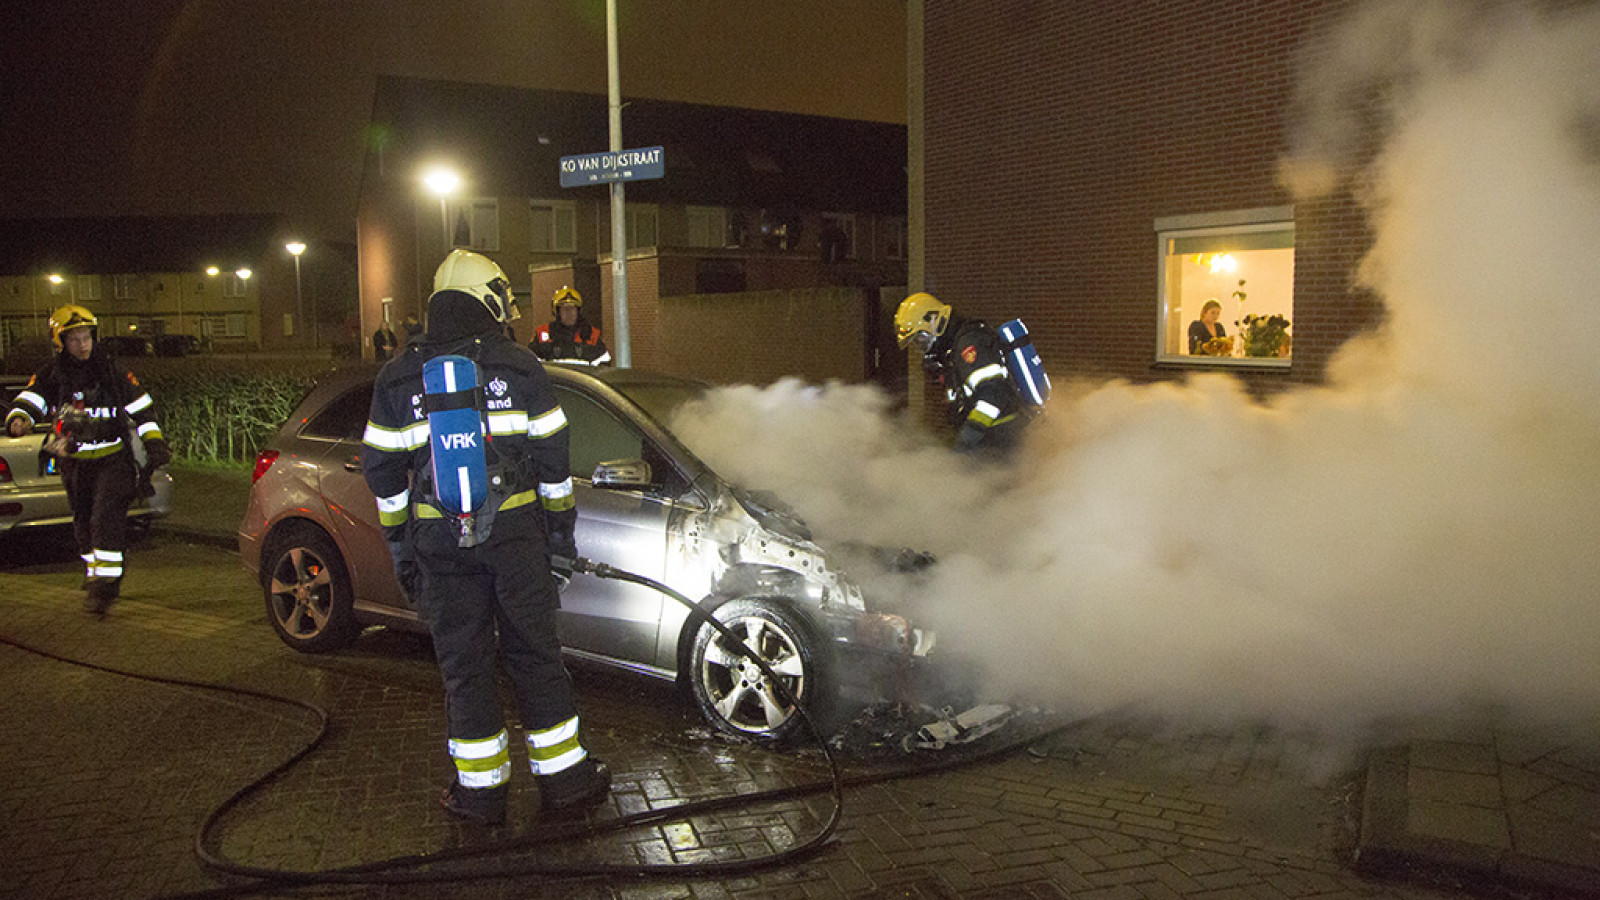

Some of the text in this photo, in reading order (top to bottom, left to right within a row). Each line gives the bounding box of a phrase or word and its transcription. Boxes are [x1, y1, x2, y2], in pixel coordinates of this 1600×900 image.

[561, 149, 661, 173] KO VAN DIJKSTRAAT
[440, 431, 478, 451] VRK
